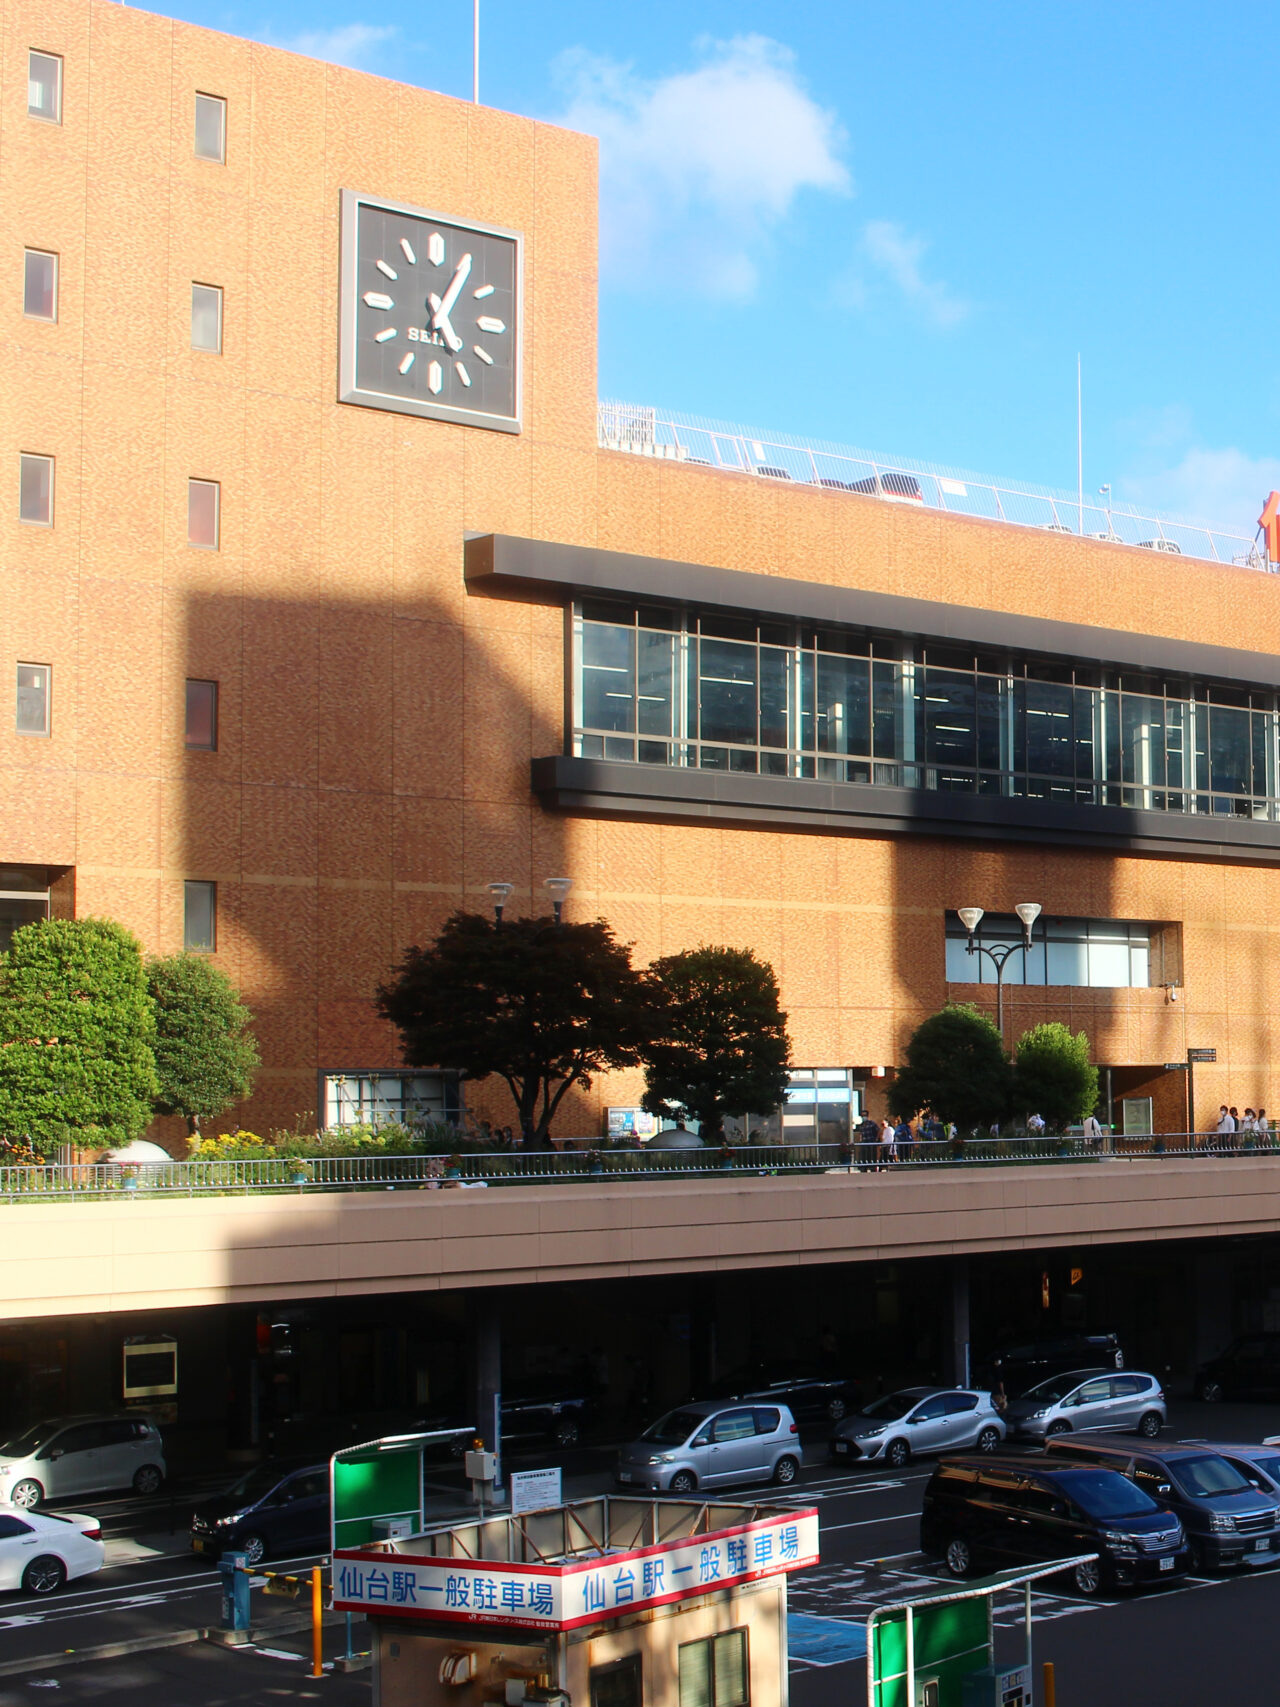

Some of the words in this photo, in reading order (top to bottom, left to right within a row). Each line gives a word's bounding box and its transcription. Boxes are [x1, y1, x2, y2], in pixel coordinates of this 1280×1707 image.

[407, 327, 463, 351] SEIO
[339, 1566, 554, 1615] 仙台駅一般駐車場
[583, 1526, 799, 1612] 仙台駅一般駐車場
